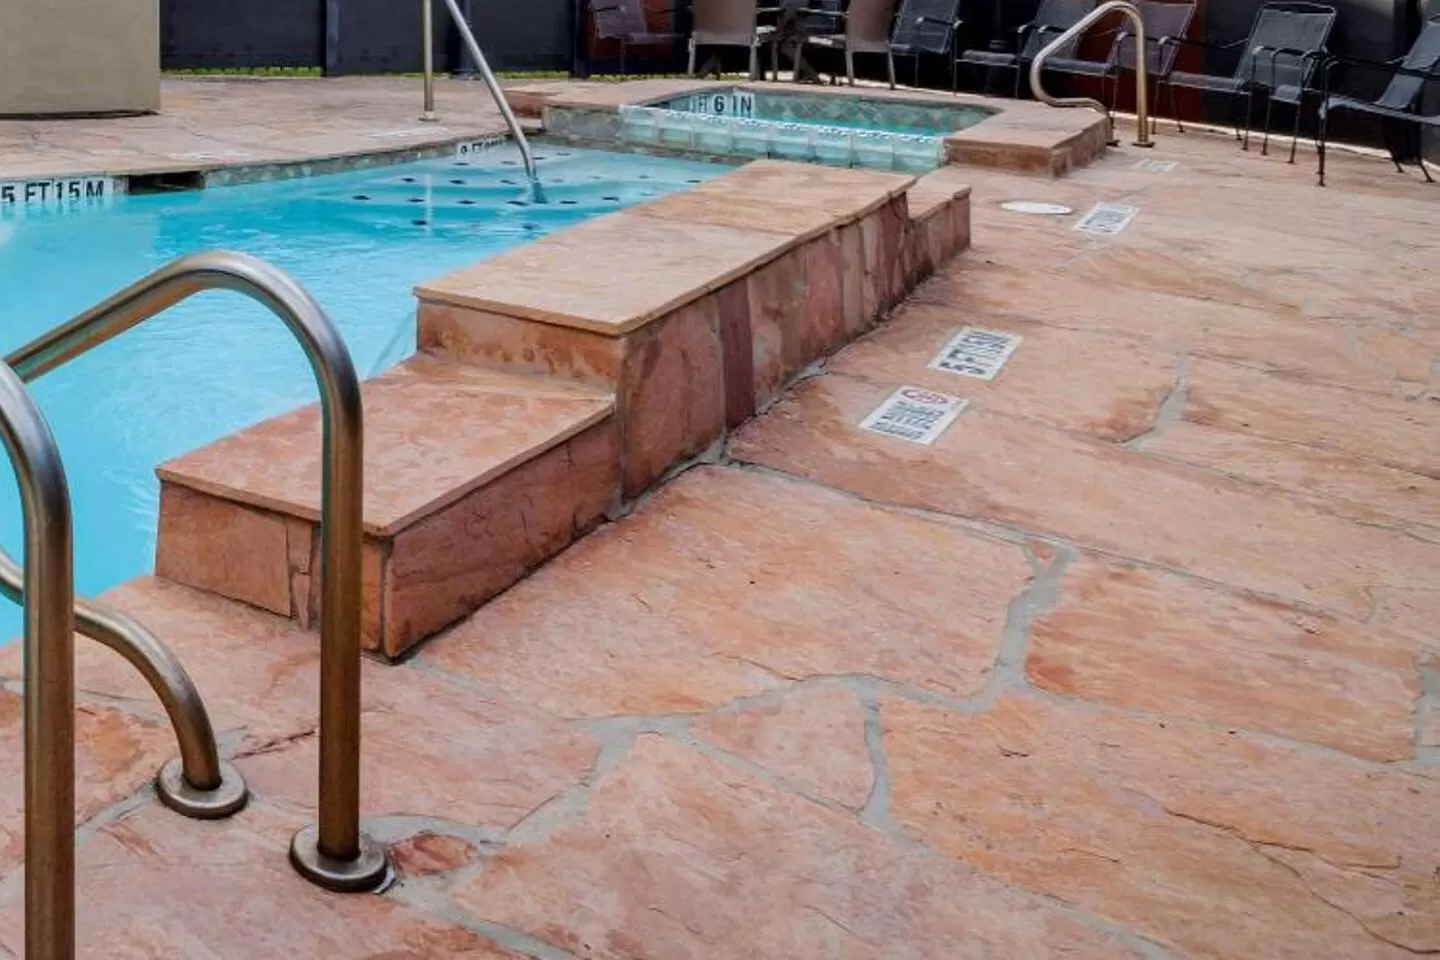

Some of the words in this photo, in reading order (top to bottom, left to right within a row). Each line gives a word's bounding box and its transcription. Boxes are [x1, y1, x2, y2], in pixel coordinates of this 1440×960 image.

[714, 95, 725, 113] 6
[733, 96, 752, 115] IN
[1, 185, 15, 203] 5
[24, 182, 51, 202] FT
